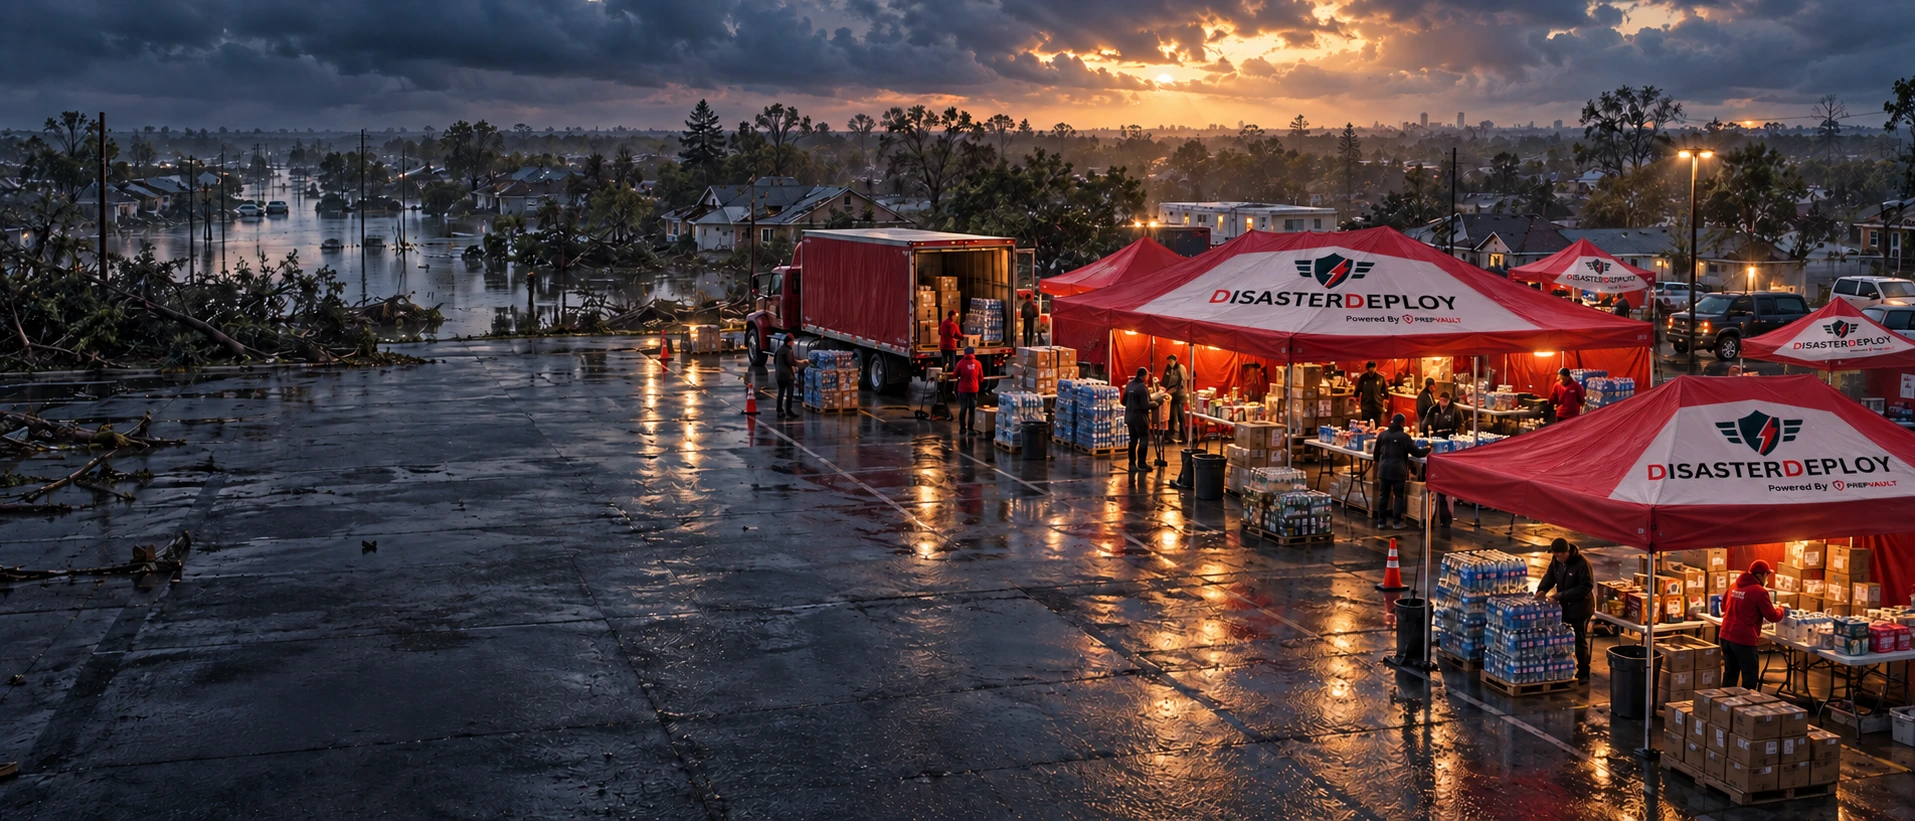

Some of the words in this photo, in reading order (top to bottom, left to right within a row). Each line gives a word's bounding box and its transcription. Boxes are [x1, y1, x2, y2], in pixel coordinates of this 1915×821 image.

[1208, 289, 1456, 310] DISASTERDEPLOY
[1346, 315, 1385, 323] Powered
[1387, 316, 1400, 325] By
[1793, 335, 1891, 350] DISASTERDEPLOY
[1647, 456, 1890, 481] DISASTERDEPLOY
[1768, 483, 1812, 492] Powered
[1814, 483, 1828, 492] By
[1846, 480, 1897, 489] PREPVAULT
